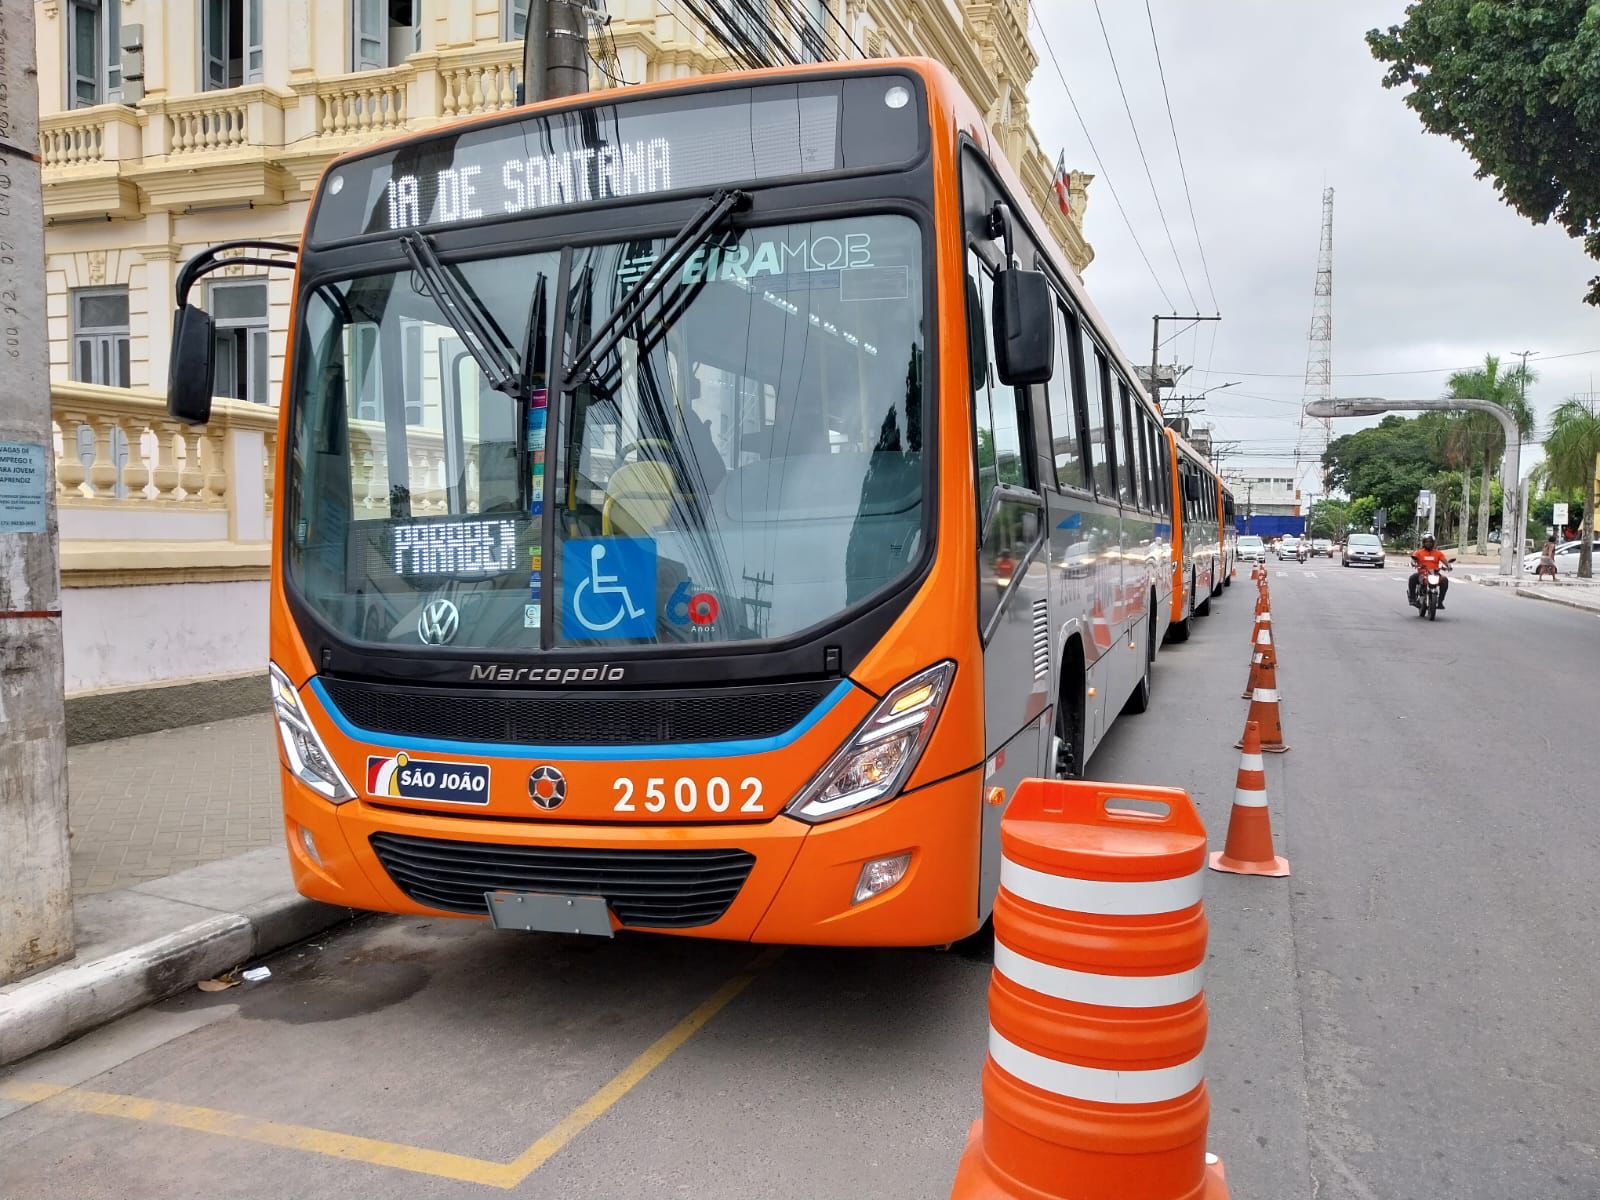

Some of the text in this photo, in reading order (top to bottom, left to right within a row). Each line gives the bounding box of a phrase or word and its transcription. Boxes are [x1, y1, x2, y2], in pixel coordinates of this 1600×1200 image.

[437, 165, 482, 222] DE
[502, 136, 671, 214] SANTANA
[469, 664, 625, 684] Marcopolo
[400, 766, 486, 792] SÃO JOÃO
[612, 777, 764, 813] 25002
